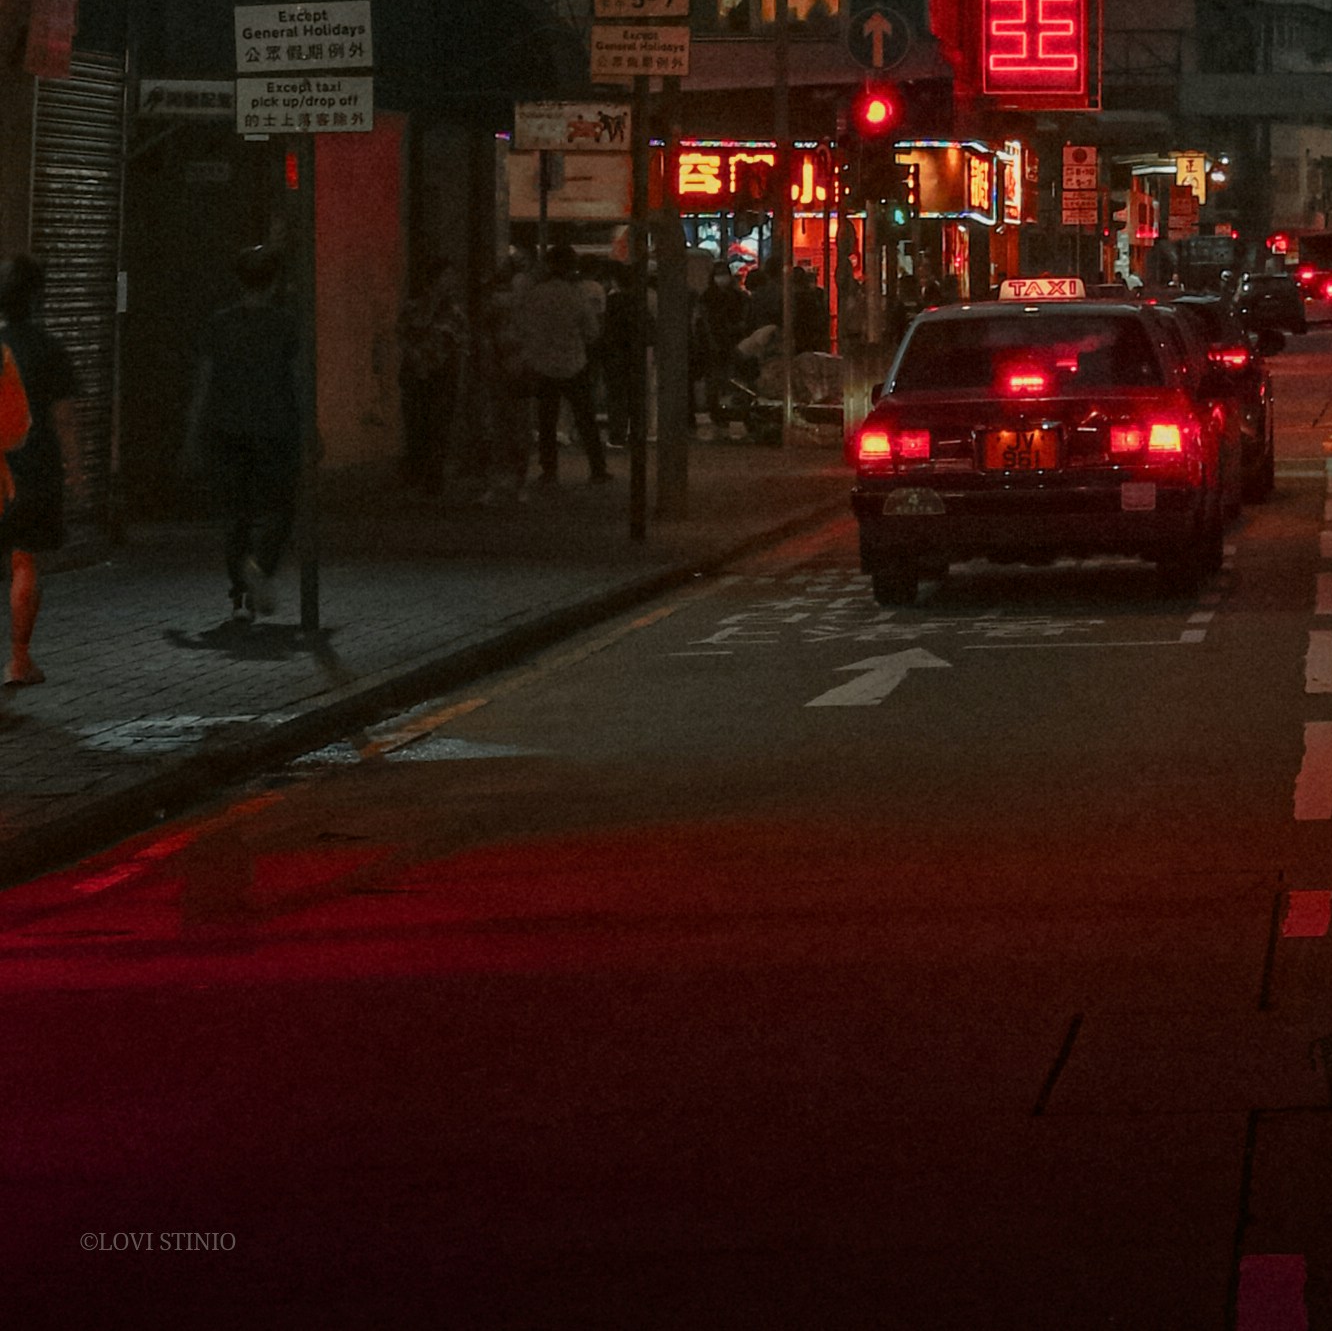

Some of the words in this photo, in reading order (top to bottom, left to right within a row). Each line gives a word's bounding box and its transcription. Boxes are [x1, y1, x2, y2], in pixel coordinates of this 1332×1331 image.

[278, 10, 328, 23] Except
[242, 26, 298, 39] General
[303, 24, 365, 37] Holidays
[266, 82, 312, 95] Except
[316, 81, 341, 92] taxi
[251, 97, 279, 108] pick
[339, 95, 358, 106] off
[1008, 280, 1077, 297] TAXI
